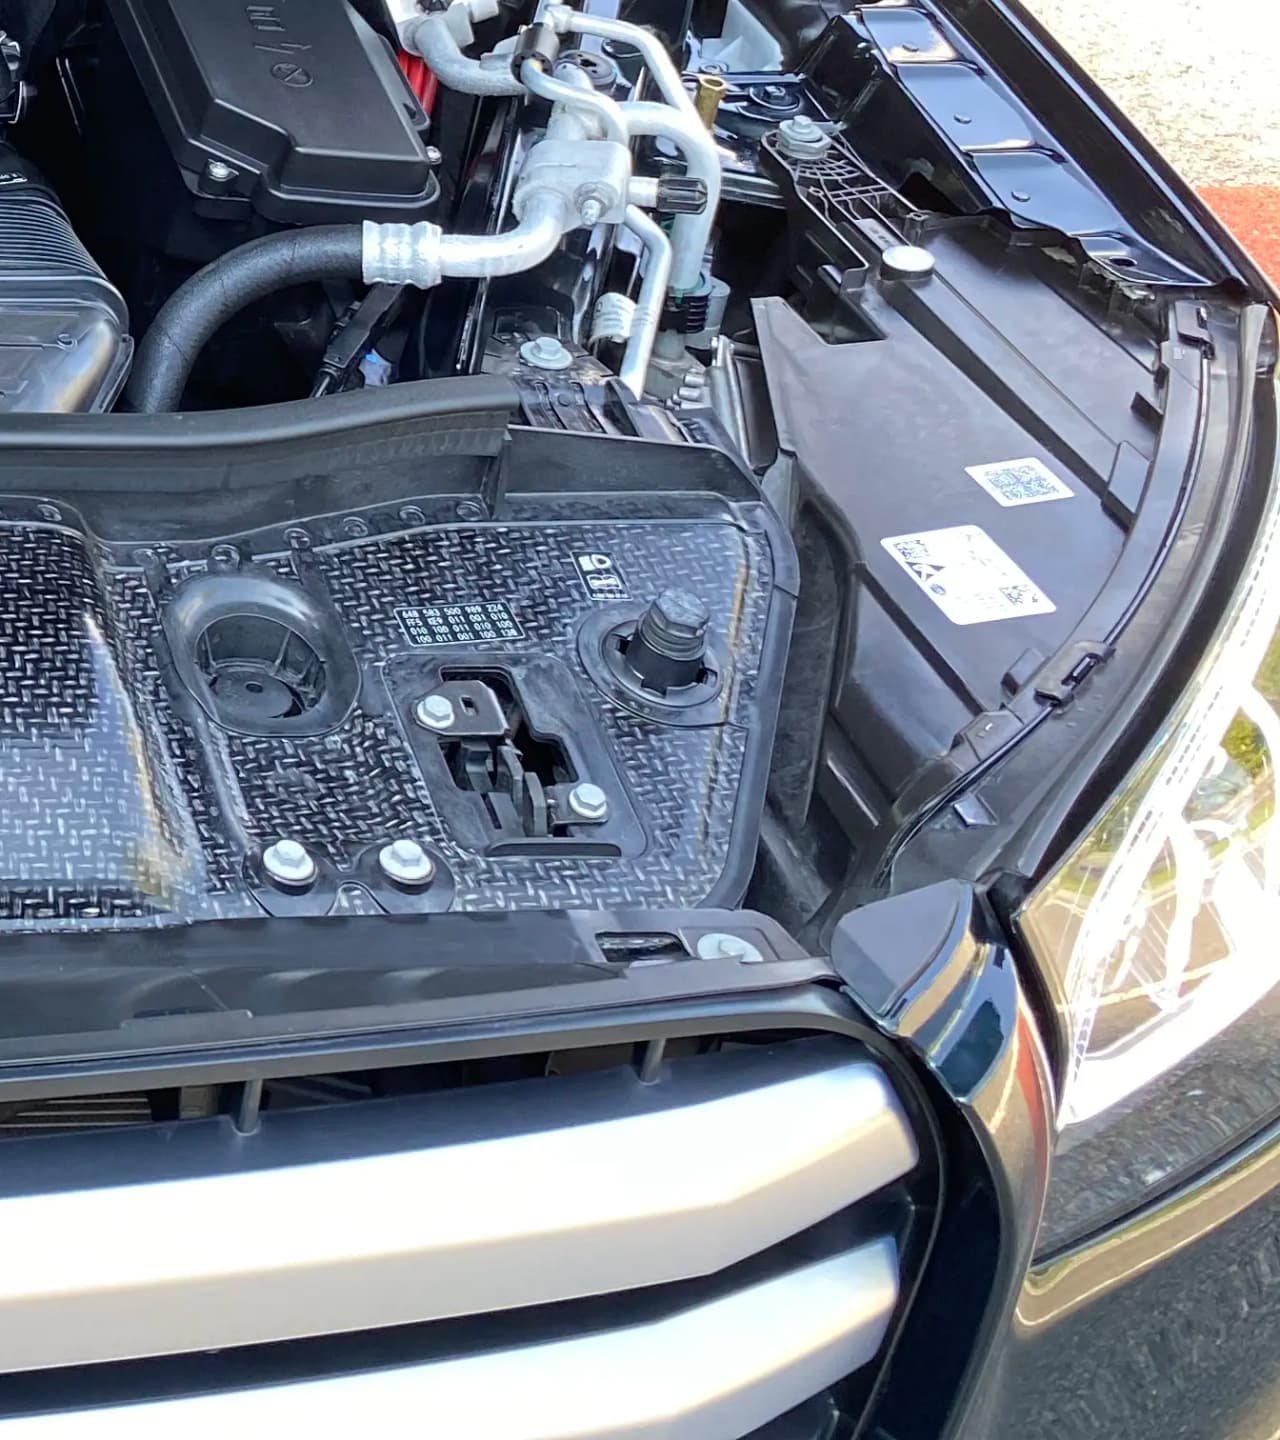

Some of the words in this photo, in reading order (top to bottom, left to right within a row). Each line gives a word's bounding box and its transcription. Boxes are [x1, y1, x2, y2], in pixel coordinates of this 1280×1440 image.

[444, 607, 461, 615] 500
[406, 618, 423, 626] FF5
[410, 627, 428, 635] 010
[453, 624, 470, 632] 011
[474, 622, 491, 631] 010
[496, 621, 513, 629] 100
[436, 634, 453, 642] 011
[479, 631, 496, 639] 100
